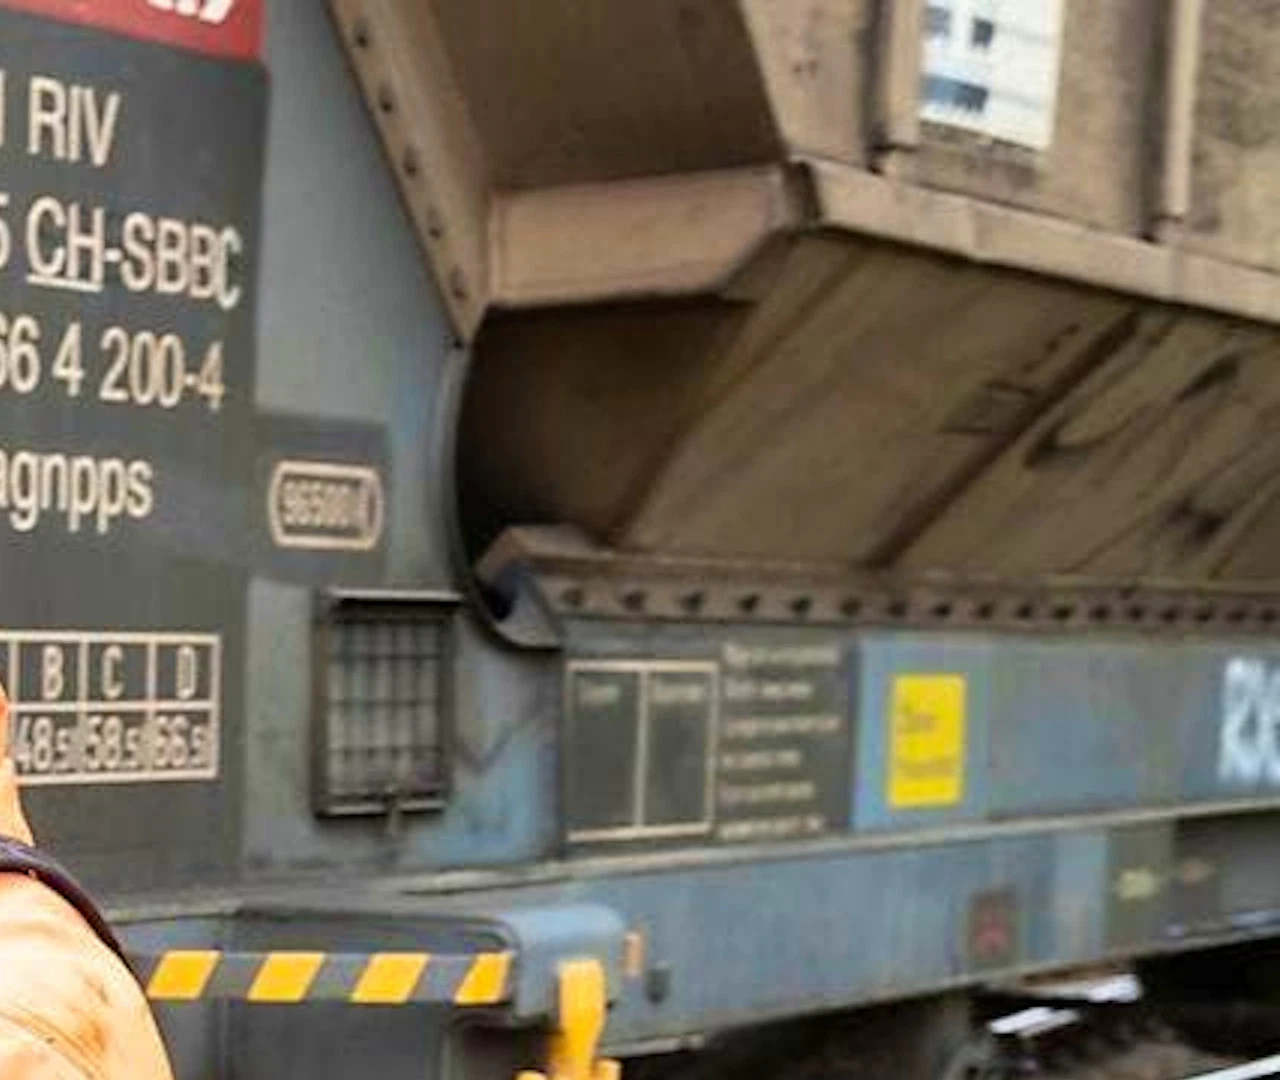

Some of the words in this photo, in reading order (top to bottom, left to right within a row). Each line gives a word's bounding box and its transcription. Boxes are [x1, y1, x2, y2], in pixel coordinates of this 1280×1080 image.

[26, 75, 121, 168] RIV
[26, 197, 242, 310] CH-SBBC
[52, 323, 85, 398] 4
[99, 326, 226, 410] 200-4
[42, 644, 64, 700] B
[102, 643, 125, 699] C
[175, 644, 198, 700] D
